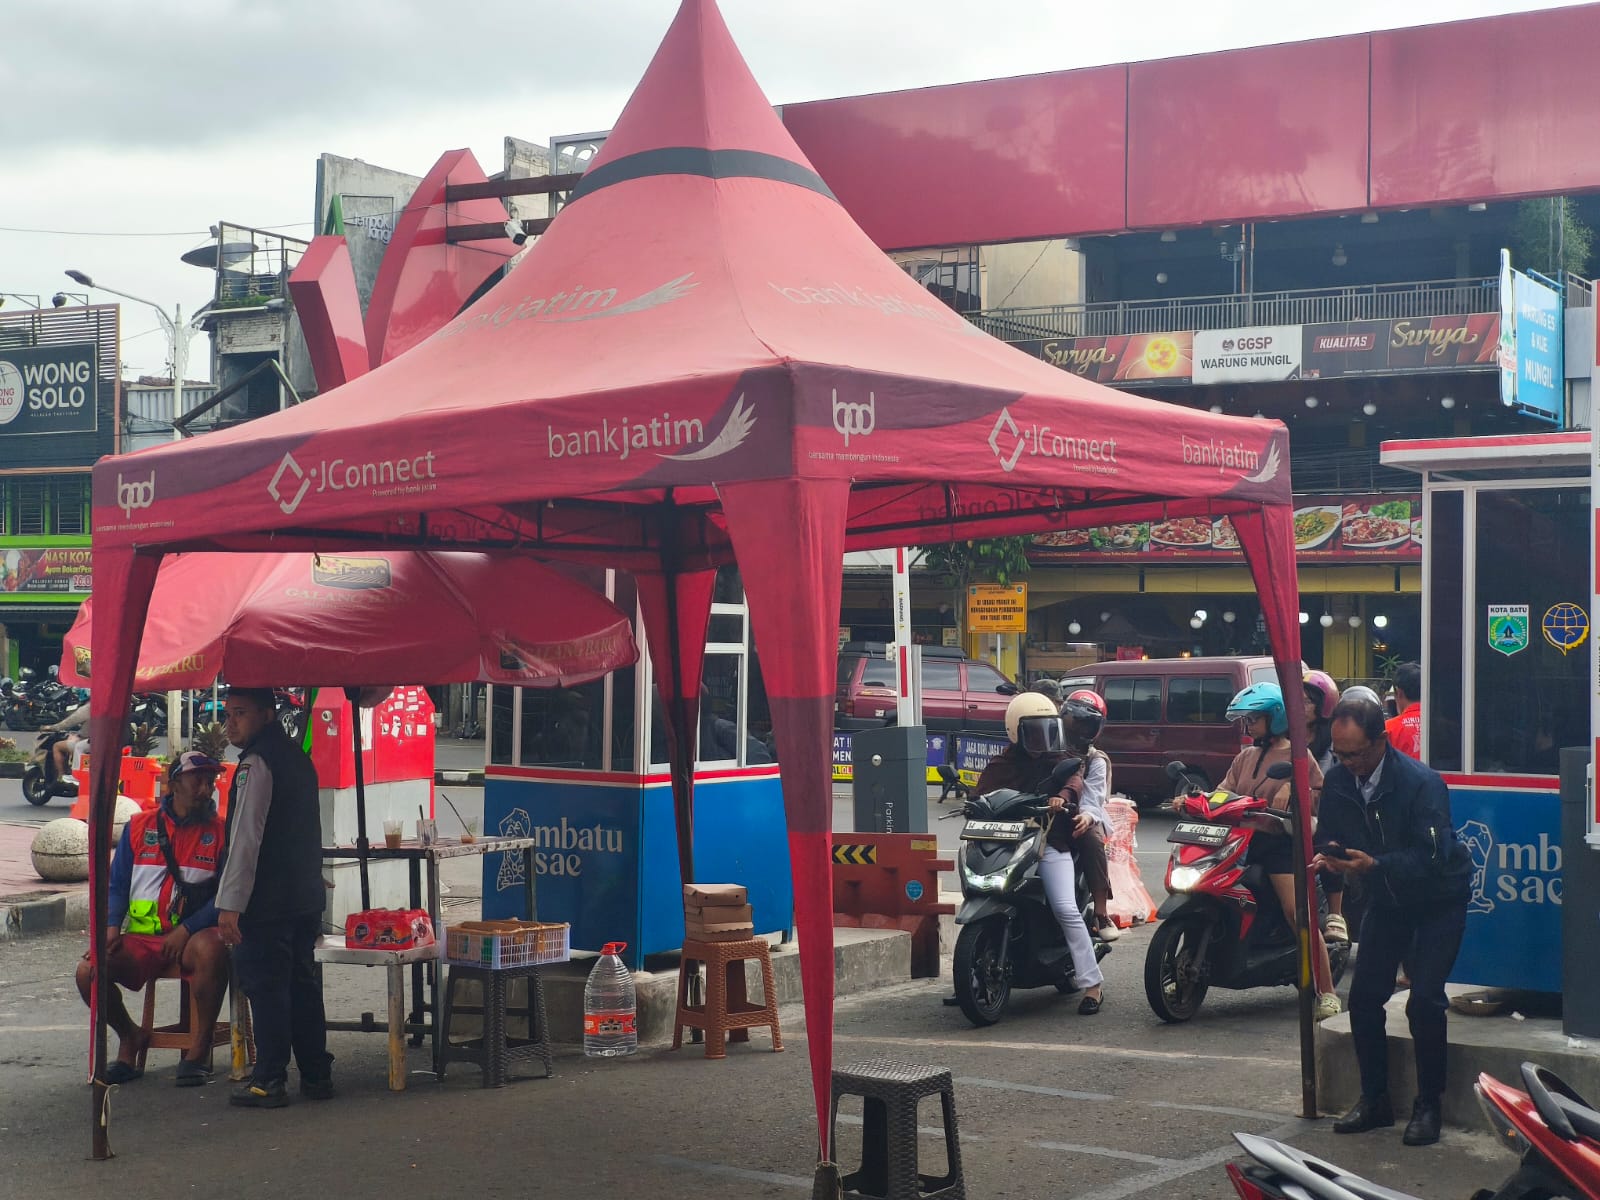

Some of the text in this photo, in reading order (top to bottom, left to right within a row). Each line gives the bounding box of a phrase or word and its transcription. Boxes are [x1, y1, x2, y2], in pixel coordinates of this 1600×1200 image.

[1237, 336, 1273, 351] GGSP
[1320, 336, 1368, 349] KUALITAS
[1391, 322, 1478, 357] Surya
[24, 361, 90, 385] WONG
[1044, 342, 1115, 374] Surya
[1200, 355, 1292, 369] WARUNG MUNGIL
[1525, 359, 1554, 389] MUNGIL
[29, 386, 85, 410] SOLO
[547, 412, 704, 460] bankjatim
[1030, 424, 1117, 464] JConnect
[1181, 434, 1259, 474] bankjatim
[316, 450, 436, 492] JConnect
[46, 551, 67, 563] NASI
[534, 817, 622, 852] mbatu
[535, 852, 581, 877] sae
